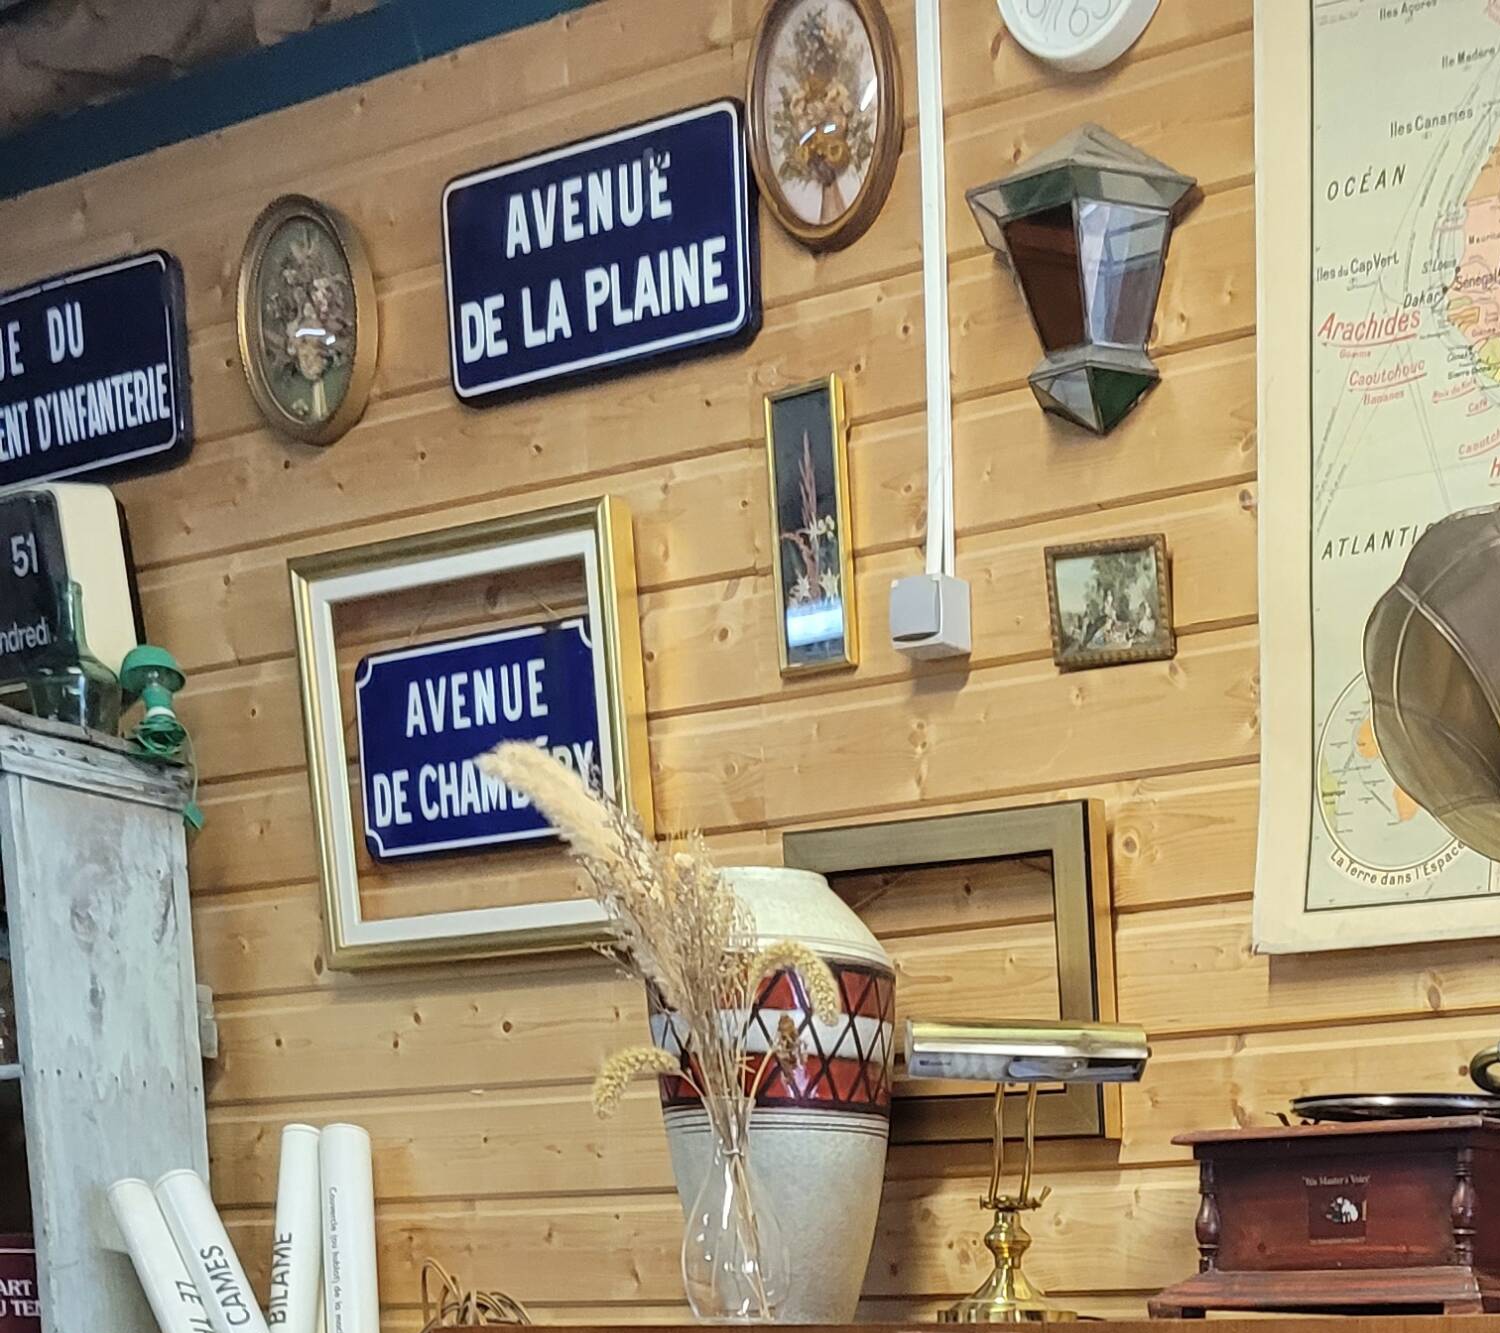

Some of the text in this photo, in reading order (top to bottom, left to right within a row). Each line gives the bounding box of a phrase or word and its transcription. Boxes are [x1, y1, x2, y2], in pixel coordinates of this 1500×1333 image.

[1390, 120, 1413, 138] Iles
[506, 152, 673, 259] AVENUE
[1327, 163, 1406, 201] OCÉAN
[460, 235, 729, 365] DE LA PLAINE
[1317, 307, 1421, 341] Arachides
[1403, 290, 1440, 308] Dakar
[47, 300, 85, 365] DU
[34, 362, 171, 451] D'INFANTERIE
[11, 532, 39, 578] 51
[1321, 523, 1430, 561] ATLANTI
[406, 658, 549, 738] AVENUE
[373, 769, 413, 828] DE
[1330, 849, 1344, 867] La
[1381, 873, 1412, 886] dans
[200, 1244, 251, 1326] CAMES
[269, 1231, 293, 1326] BILAME
